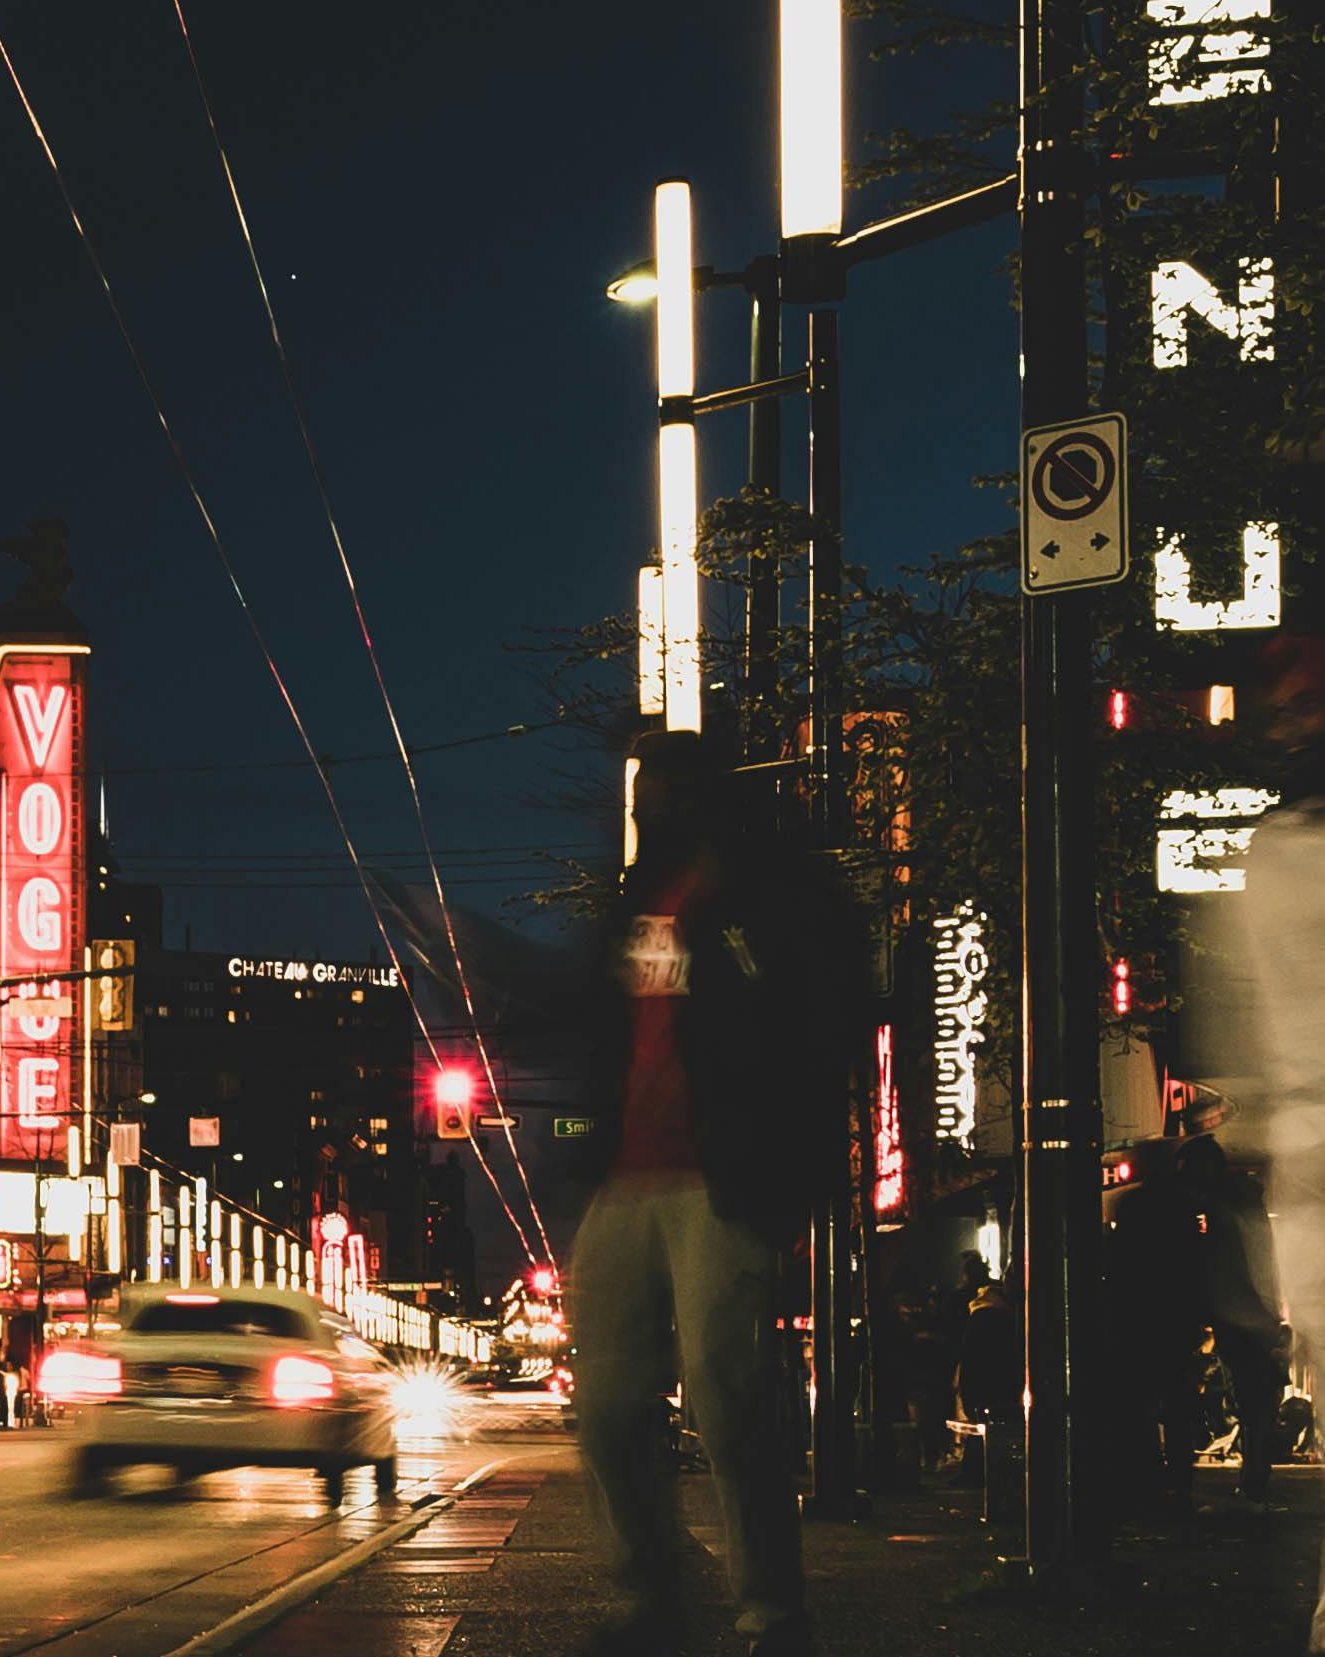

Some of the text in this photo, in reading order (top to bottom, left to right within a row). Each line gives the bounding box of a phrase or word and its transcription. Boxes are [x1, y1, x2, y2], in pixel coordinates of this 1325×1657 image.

[14, 685, 66, 1129] VOGUE
[228, 957, 399, 987] CHATEAU GRANVILLE
